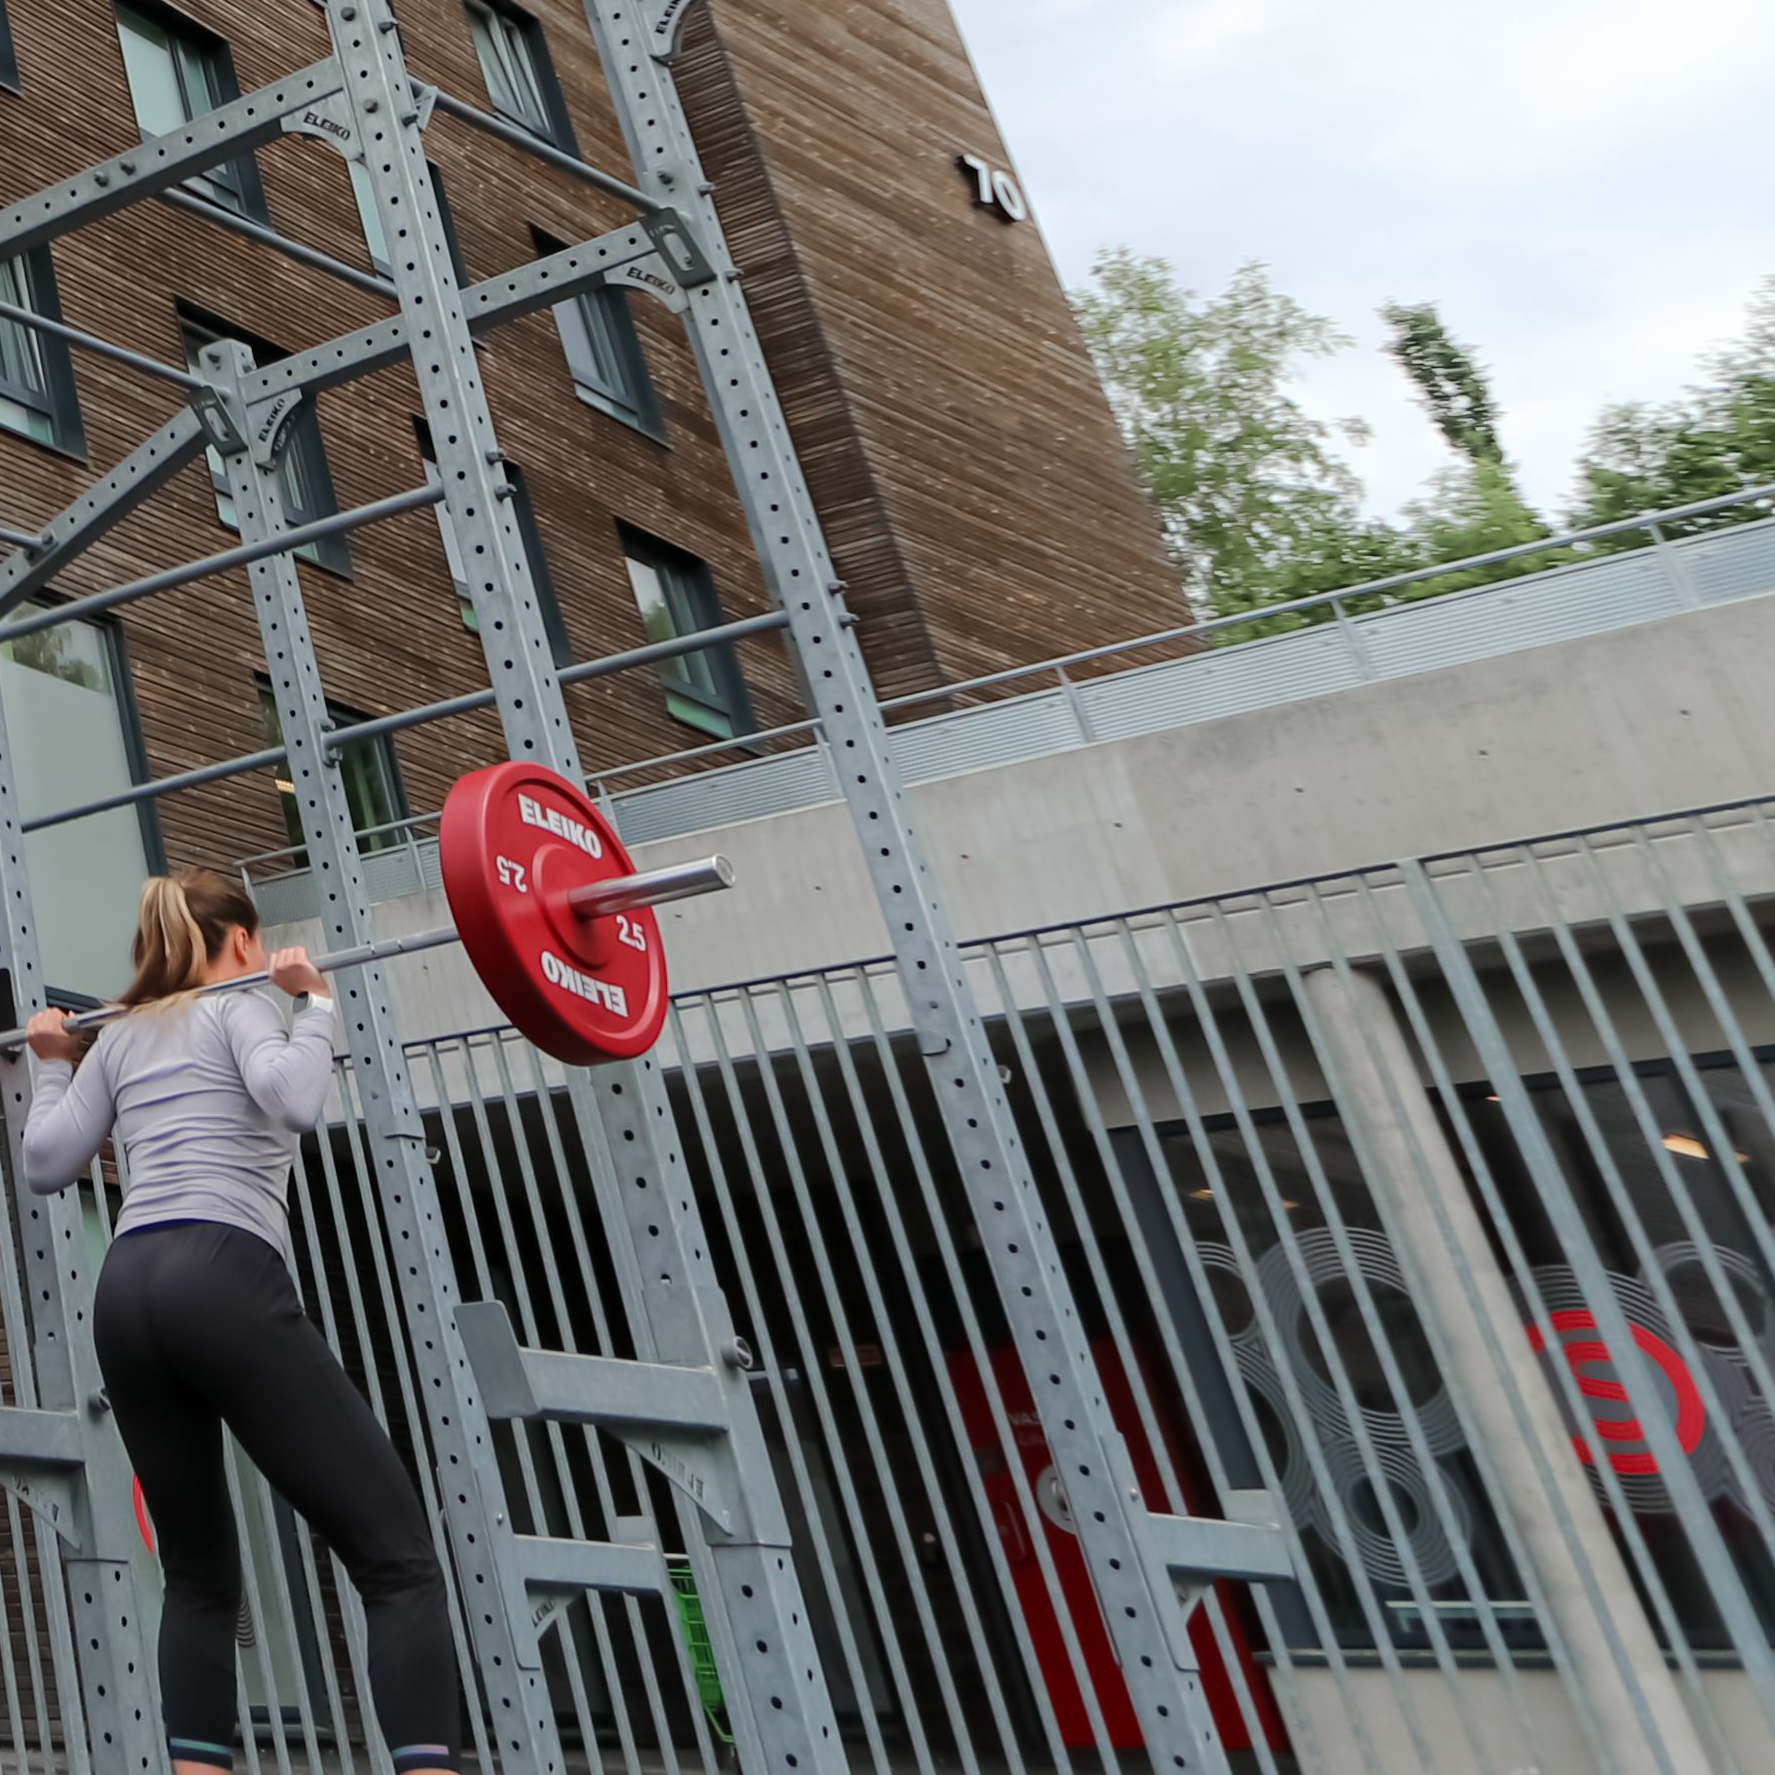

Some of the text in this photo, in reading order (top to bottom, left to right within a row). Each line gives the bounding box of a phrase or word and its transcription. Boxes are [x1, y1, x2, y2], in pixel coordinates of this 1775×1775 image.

[303, 111, 351, 141] ELEIKO
[959, 154, 1027, 221] 70
[627, 267, 675, 295] ELEIKO
[258, 398, 286, 442] ELEIKO
[517, 793, 602, 859] ELEIKO
[541, 951, 628, 1017] ELEIKO
